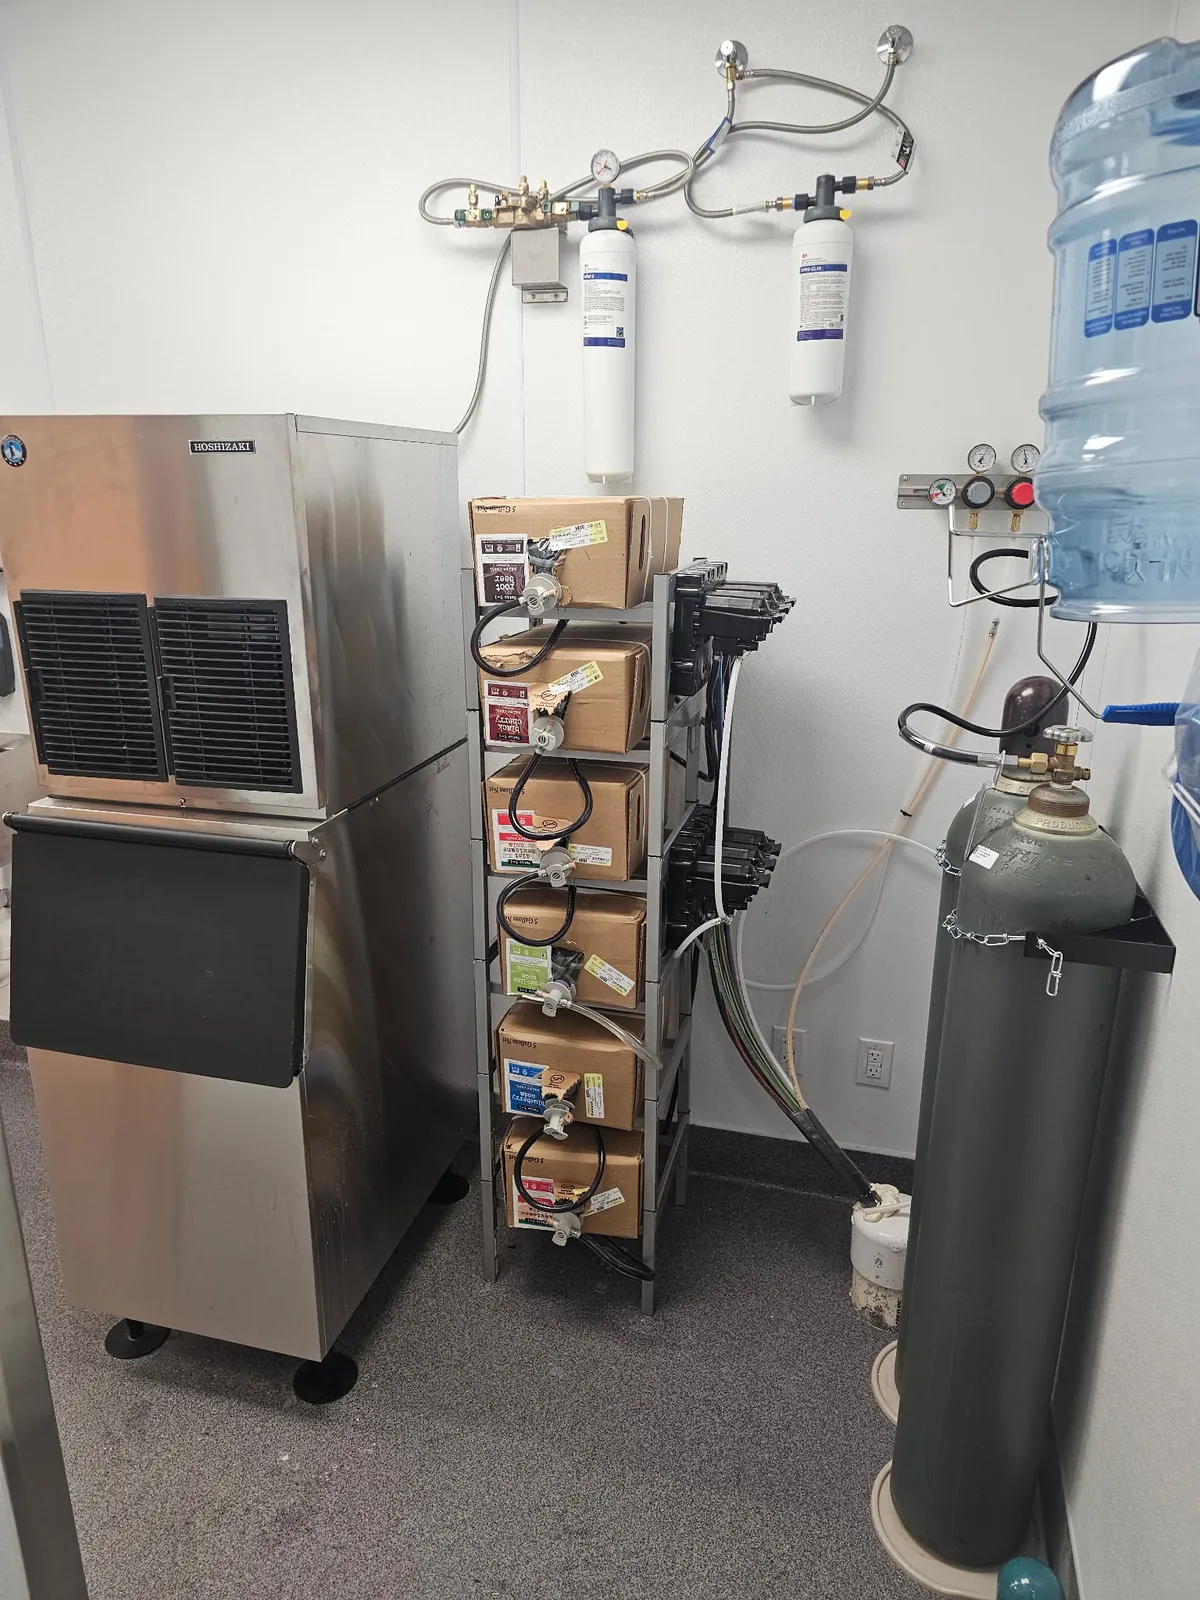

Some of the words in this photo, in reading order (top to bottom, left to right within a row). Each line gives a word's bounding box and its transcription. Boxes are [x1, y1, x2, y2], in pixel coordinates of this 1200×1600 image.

[194, 442, 250, 452] HOSHIZAKI
[494, 576, 515, 584] beer
[496, 584, 515, 592] root
[496, 715, 522, 726] cherry
[497, 724, 520, 733] black
[513, 916, 533, 924] Gallons
[512, 1038, 532, 1048] Gallons
[512, 1094, 545, 1106] blueberry
